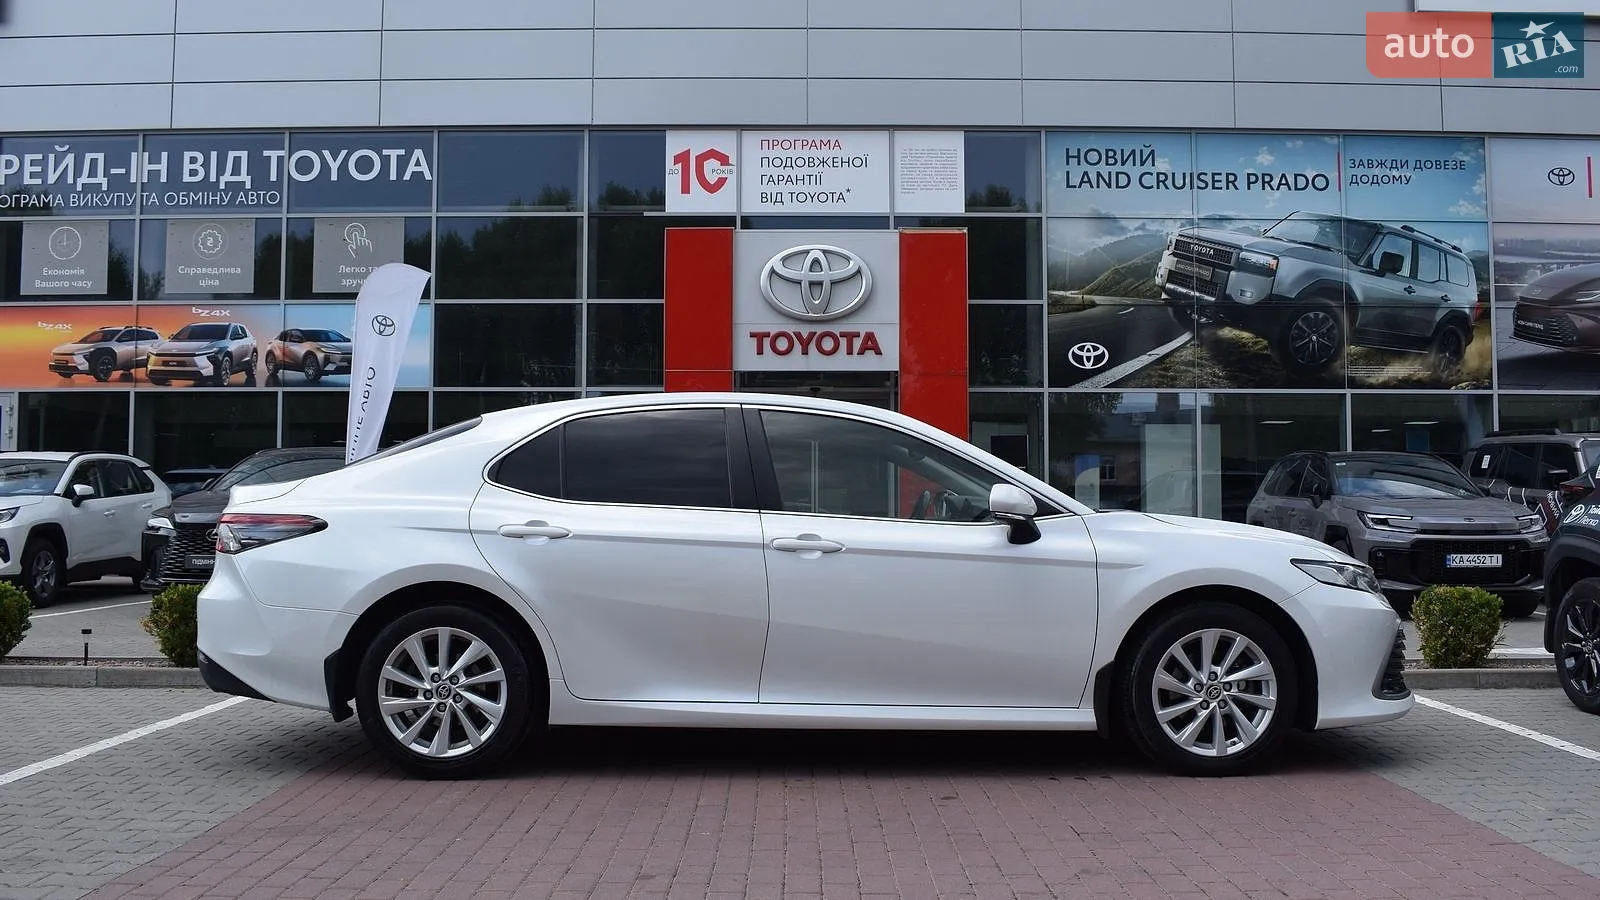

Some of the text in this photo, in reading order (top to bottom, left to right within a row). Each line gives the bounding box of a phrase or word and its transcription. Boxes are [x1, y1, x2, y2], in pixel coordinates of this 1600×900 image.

[760, 138, 842, 151] ПРОГРАМА
[760, 154, 868, 169] ПОДОВЖЕНОЇ
[1065, 144, 1156, 167] НОВИЙ
[182, 150, 251, 189] ВІД
[262, 149, 433, 182] TOYOTA
[1349, 159, 1466, 171] ЗАВЖДИ ДОВЕЗЕ
[760, 171, 823, 186] ГАРАНТІЇ
[1065, 171, 1330, 192] LAND CRUISER PRADO
[1349, 174, 1412, 186] ДОДОМУ
[70, 193, 137, 206] ВИКУПУ
[142, 192, 159, 206] ТА
[164, 191, 232, 206] ОБМІНУ
[236, 190, 280, 205] АВТО
[760, 191, 785, 206] ВІД
[1190, 244, 1214, 256] TOYOTA
[42, 267, 85, 276] Економія
[177, 265, 241, 275] Справедлива
[339, 265, 366, 273] Легко
[35, 279, 92, 289] Вашого часу
[199, 277, 219, 287] ціна
[750, 330, 883, 356] TOYOTA
[1451, 555, 1465, 565] KA
[1466, 555, 1487, 565] 4452
